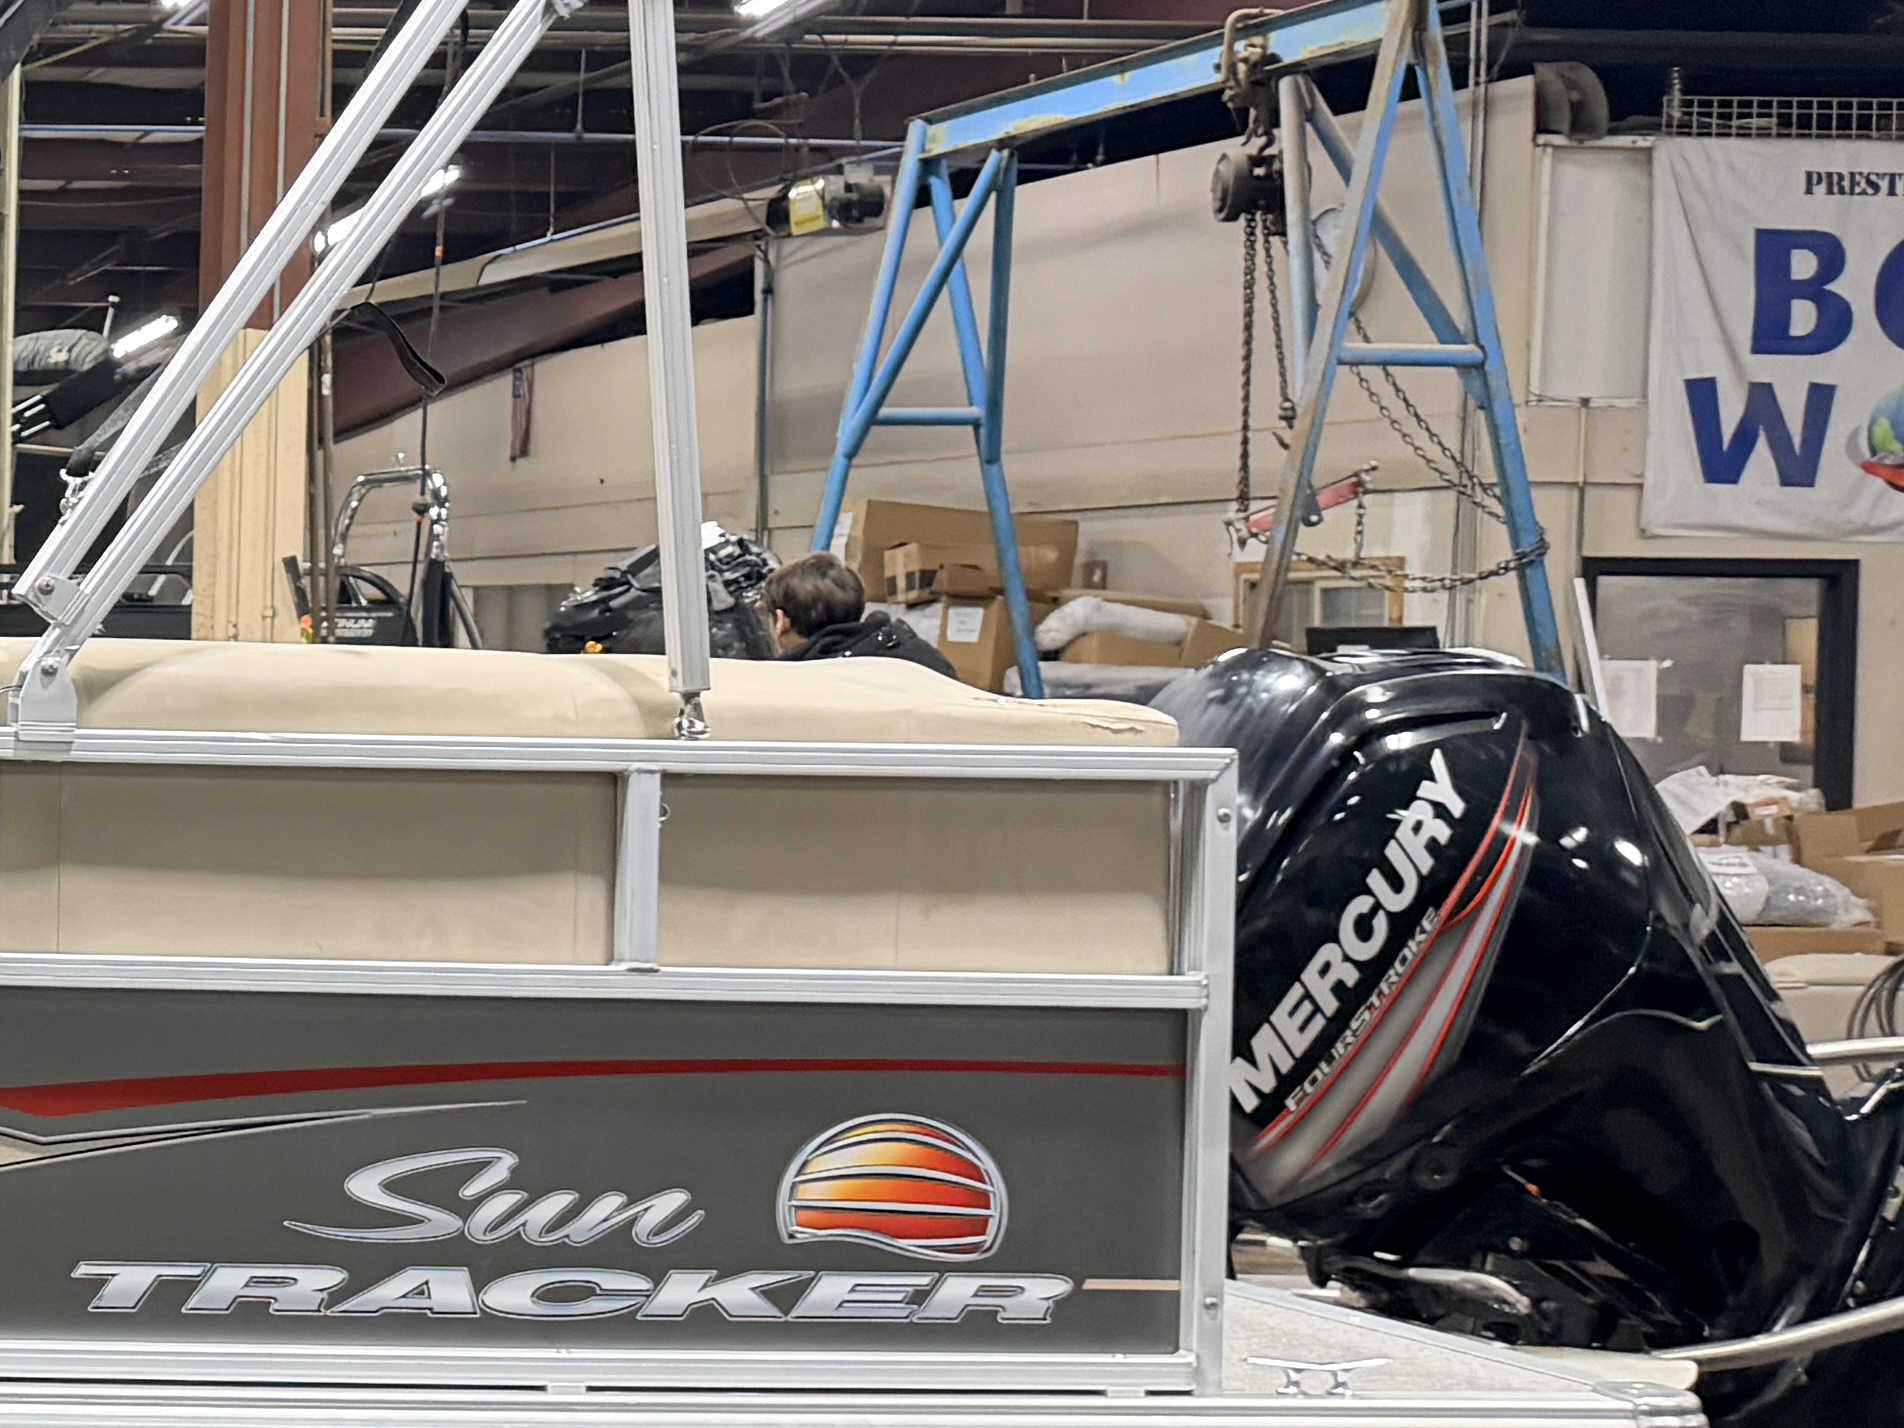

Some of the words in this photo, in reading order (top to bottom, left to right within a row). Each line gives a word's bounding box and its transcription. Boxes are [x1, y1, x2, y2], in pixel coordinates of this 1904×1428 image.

[1804, 171, 1904, 197] PREST
[1751, 228, 1904, 356] B
[1229, 748, 1466, 1113] MERCURY
[1284, 906, 1441, 1112] FOURSTROKE
[284, 1148, 705, 1247] Sun
[71, 1261, 1074, 1324] TRACKER
